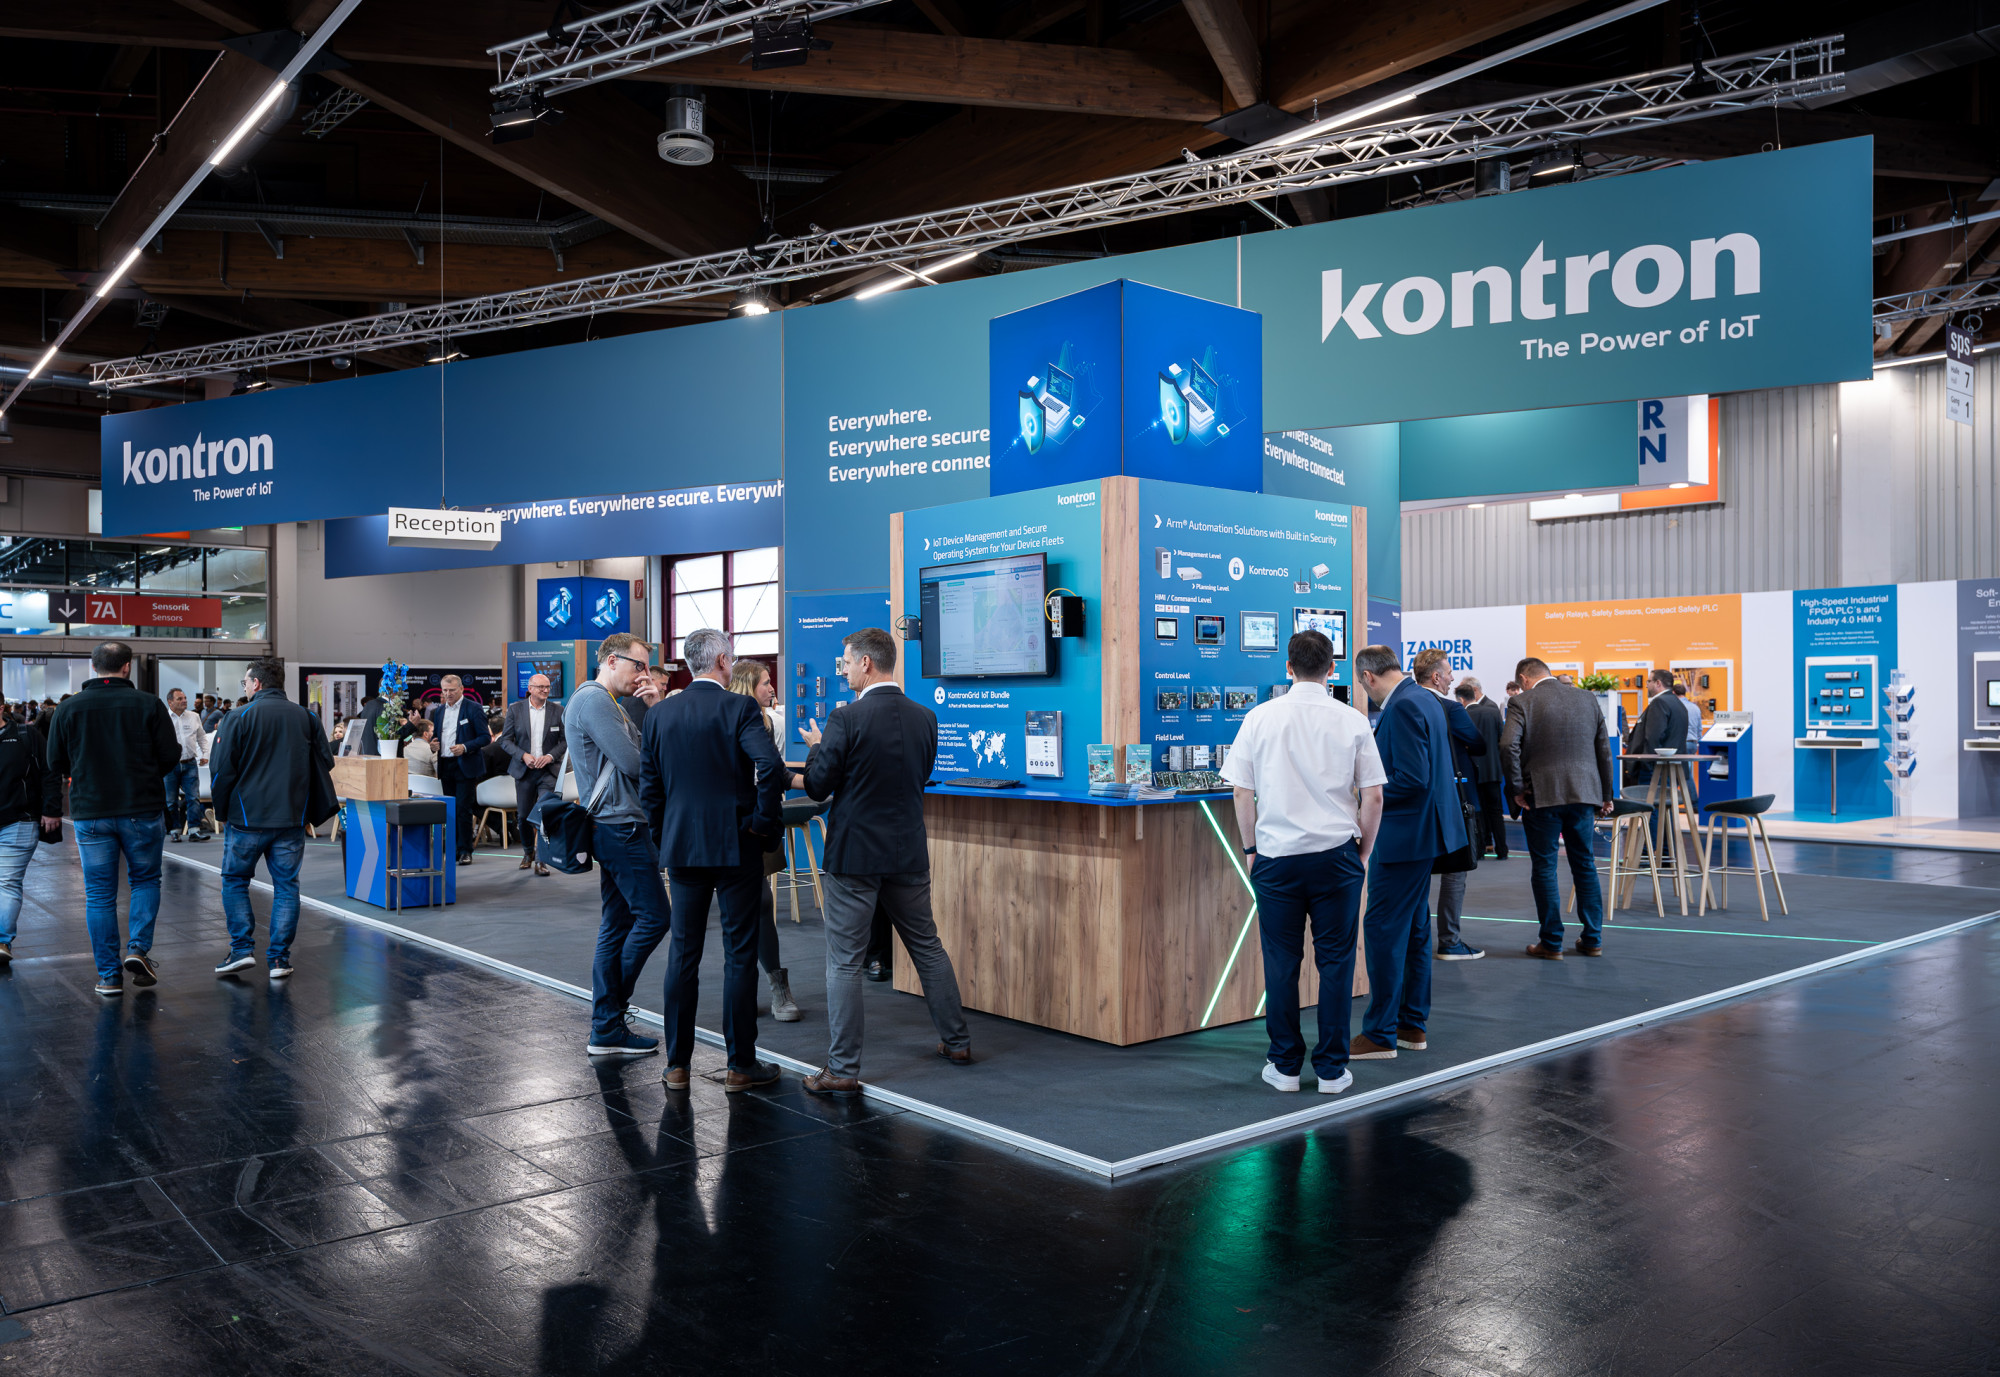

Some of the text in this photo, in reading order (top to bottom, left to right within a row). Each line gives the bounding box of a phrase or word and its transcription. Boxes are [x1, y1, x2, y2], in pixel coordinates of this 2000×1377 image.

[691, 111, 699, 120] 02
[691, 120, 699, 130] 05
[1322, 232, 1760, 344] kontron
[1520, 314, 1760, 360] The Power of IoT
[1950, 331, 1970, 359] sps
[1964, 371, 1970, 388] 7
[1642, 400, 1665, 431] R
[1965, 402, 1969, 418] 1
[829, 409, 932, 432] Everywhere.
[829, 428, 990, 458] Everywhere secure
[1310, 434, 1334, 456] secure.
[1639, 433, 1667, 465] N
[123, 431, 273, 486] kontron
[1264, 438, 1345, 486] Everywhere connected.
[829, 460, 927, 483] Everywhere
[193, 481, 273, 502] The Power of IoT
[1057, 492, 1095, 505] kontron
[570, 495, 654, 516] Everywhere
[658, 490, 713, 507] secure.
[1315, 509, 1348, 523] kontron
[395, 514, 496, 536] Reception
[1166, 518, 1337, 546] Arm® Automation Solutions with Built in Security
[933, 524, 1047, 547] IoT Device Management and Secure
[933, 536, 1064, 562] Operating System for Your Device Fleets
[1178, 550, 1207, 560] Management
[1249, 565, 1289, 577] KontronOS
[1196, 584, 1217, 592] Planning
[1976, 588, 1998, 598] Soft-
[152, 602, 190, 612] Sensorik
[1171, 594, 1197, 603] Command
[1198, 596, 1212, 604] Level
[1801, 595, 1889, 607] High-Speed Industrial
[91, 601, 117, 619] 7A
[152, 613, 183, 622] Sensors
[1544, 604, 1718, 620] Safety Relays, Safety Sensors, Compact Safety PLC
[1809, 607, 1834, 616] FPGA
[1863, 605, 1880, 613] and
[1807, 617, 1839, 626] Industry
[1841, 616, 1855, 624] 4.0
[1407, 639, 1472, 655] ZANDER
[1407, 656, 1473, 672] AEN
[948, 691, 1010, 699] KontronGrid IoT Bundle
